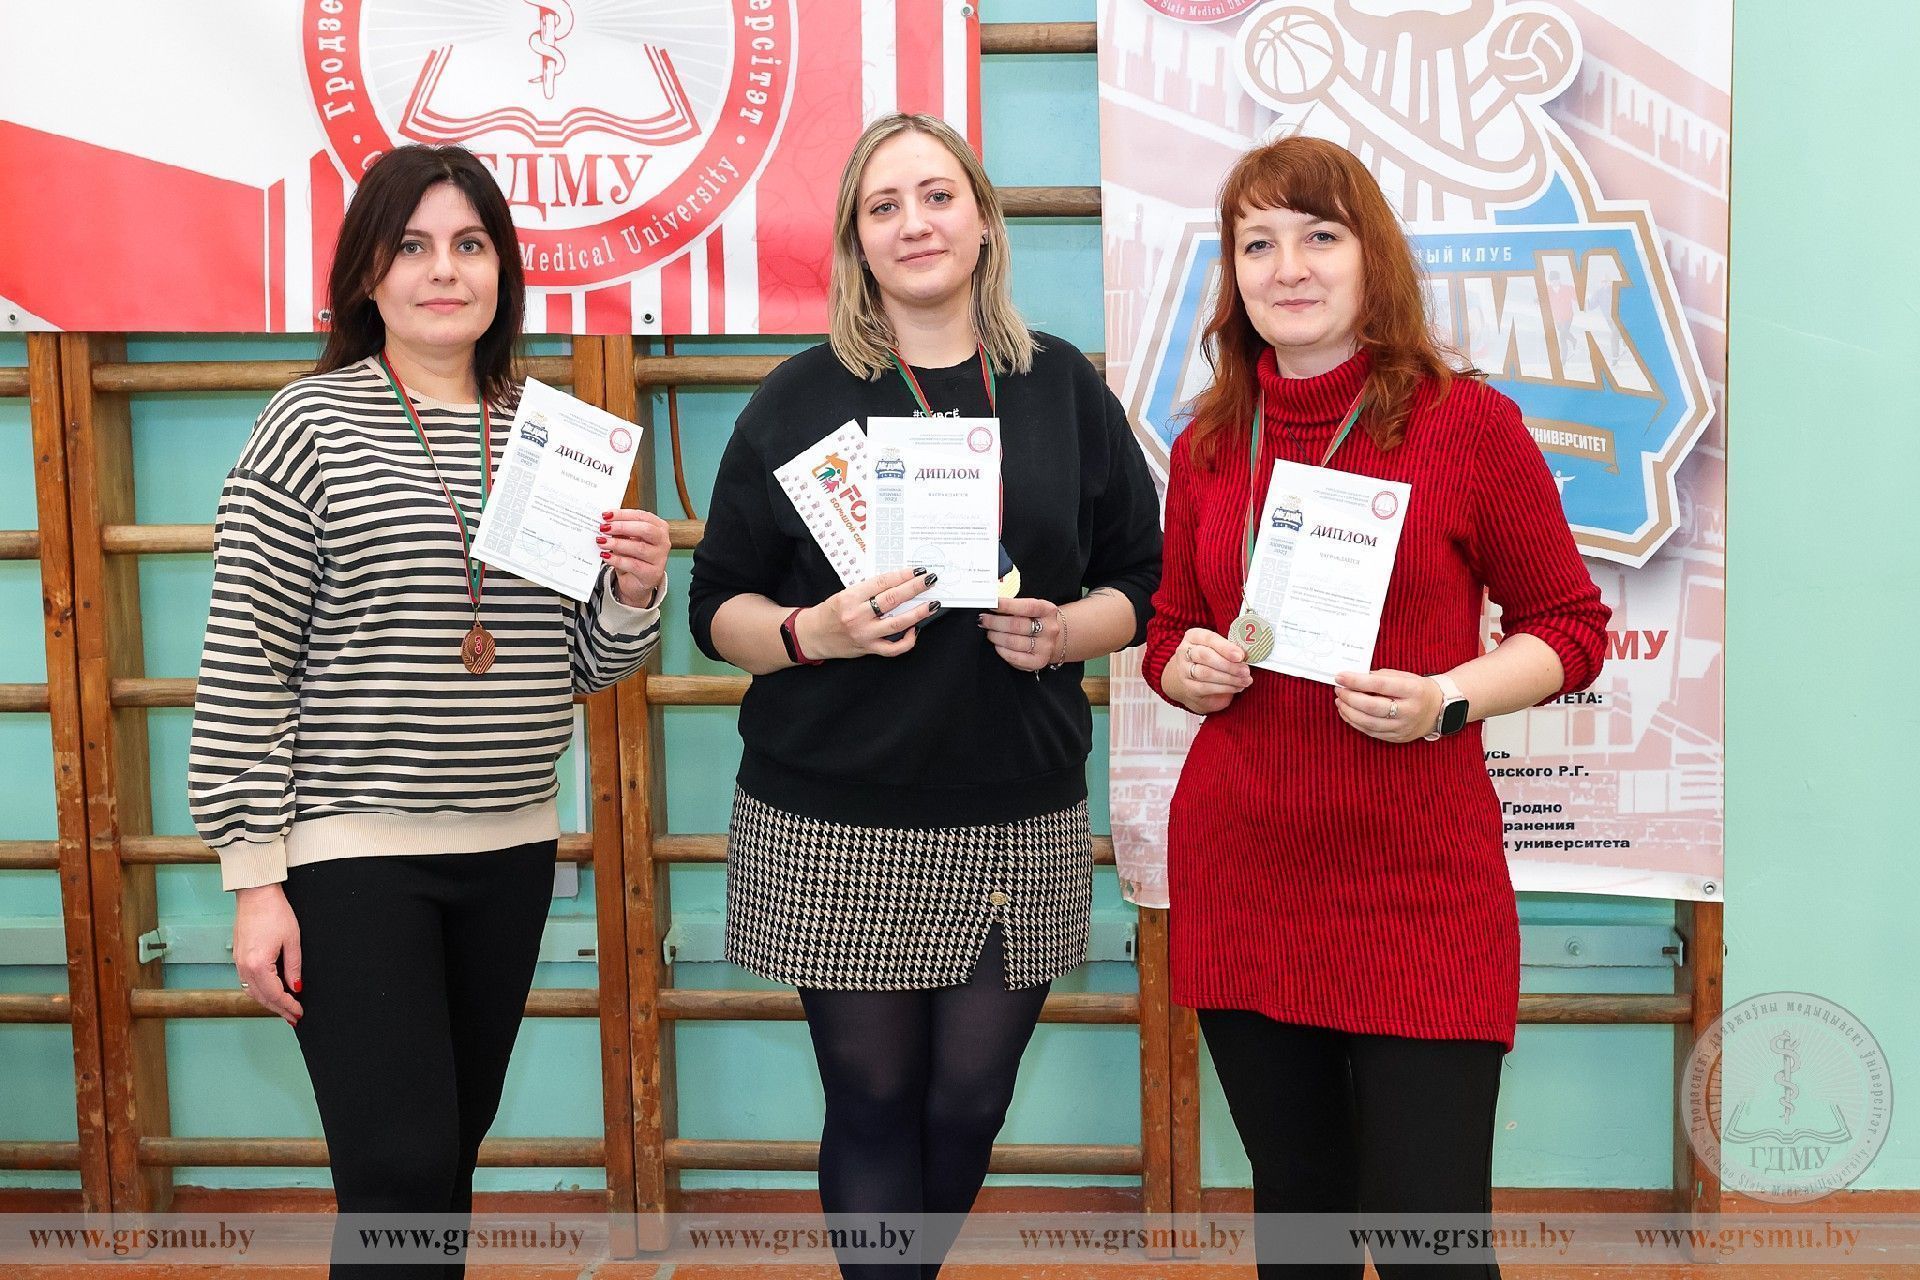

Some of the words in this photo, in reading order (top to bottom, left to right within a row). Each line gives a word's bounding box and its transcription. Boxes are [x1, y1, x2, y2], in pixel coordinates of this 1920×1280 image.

[1189, 3, 1226, 16] Medical
[519, 236, 616, 272] Medical
[620, 156, 739, 255] University
[1462, 246, 1512, 263] КЛУБ
[554, 444, 614, 477] ДИПЛОМ
[914, 467, 980, 482] ДИПЛОМ
[1310, 523, 1379, 548] ДИПЛОМ
[1245, 623, 1256, 643] 2
[1488, 767, 1552, 778] овского
[1558, 765, 1589, 777] Р.Г.
[1502, 802, 1562, 815] Гродно
[1504, 821, 1575, 833] ранения
[1514, 839, 1630, 851] университета
